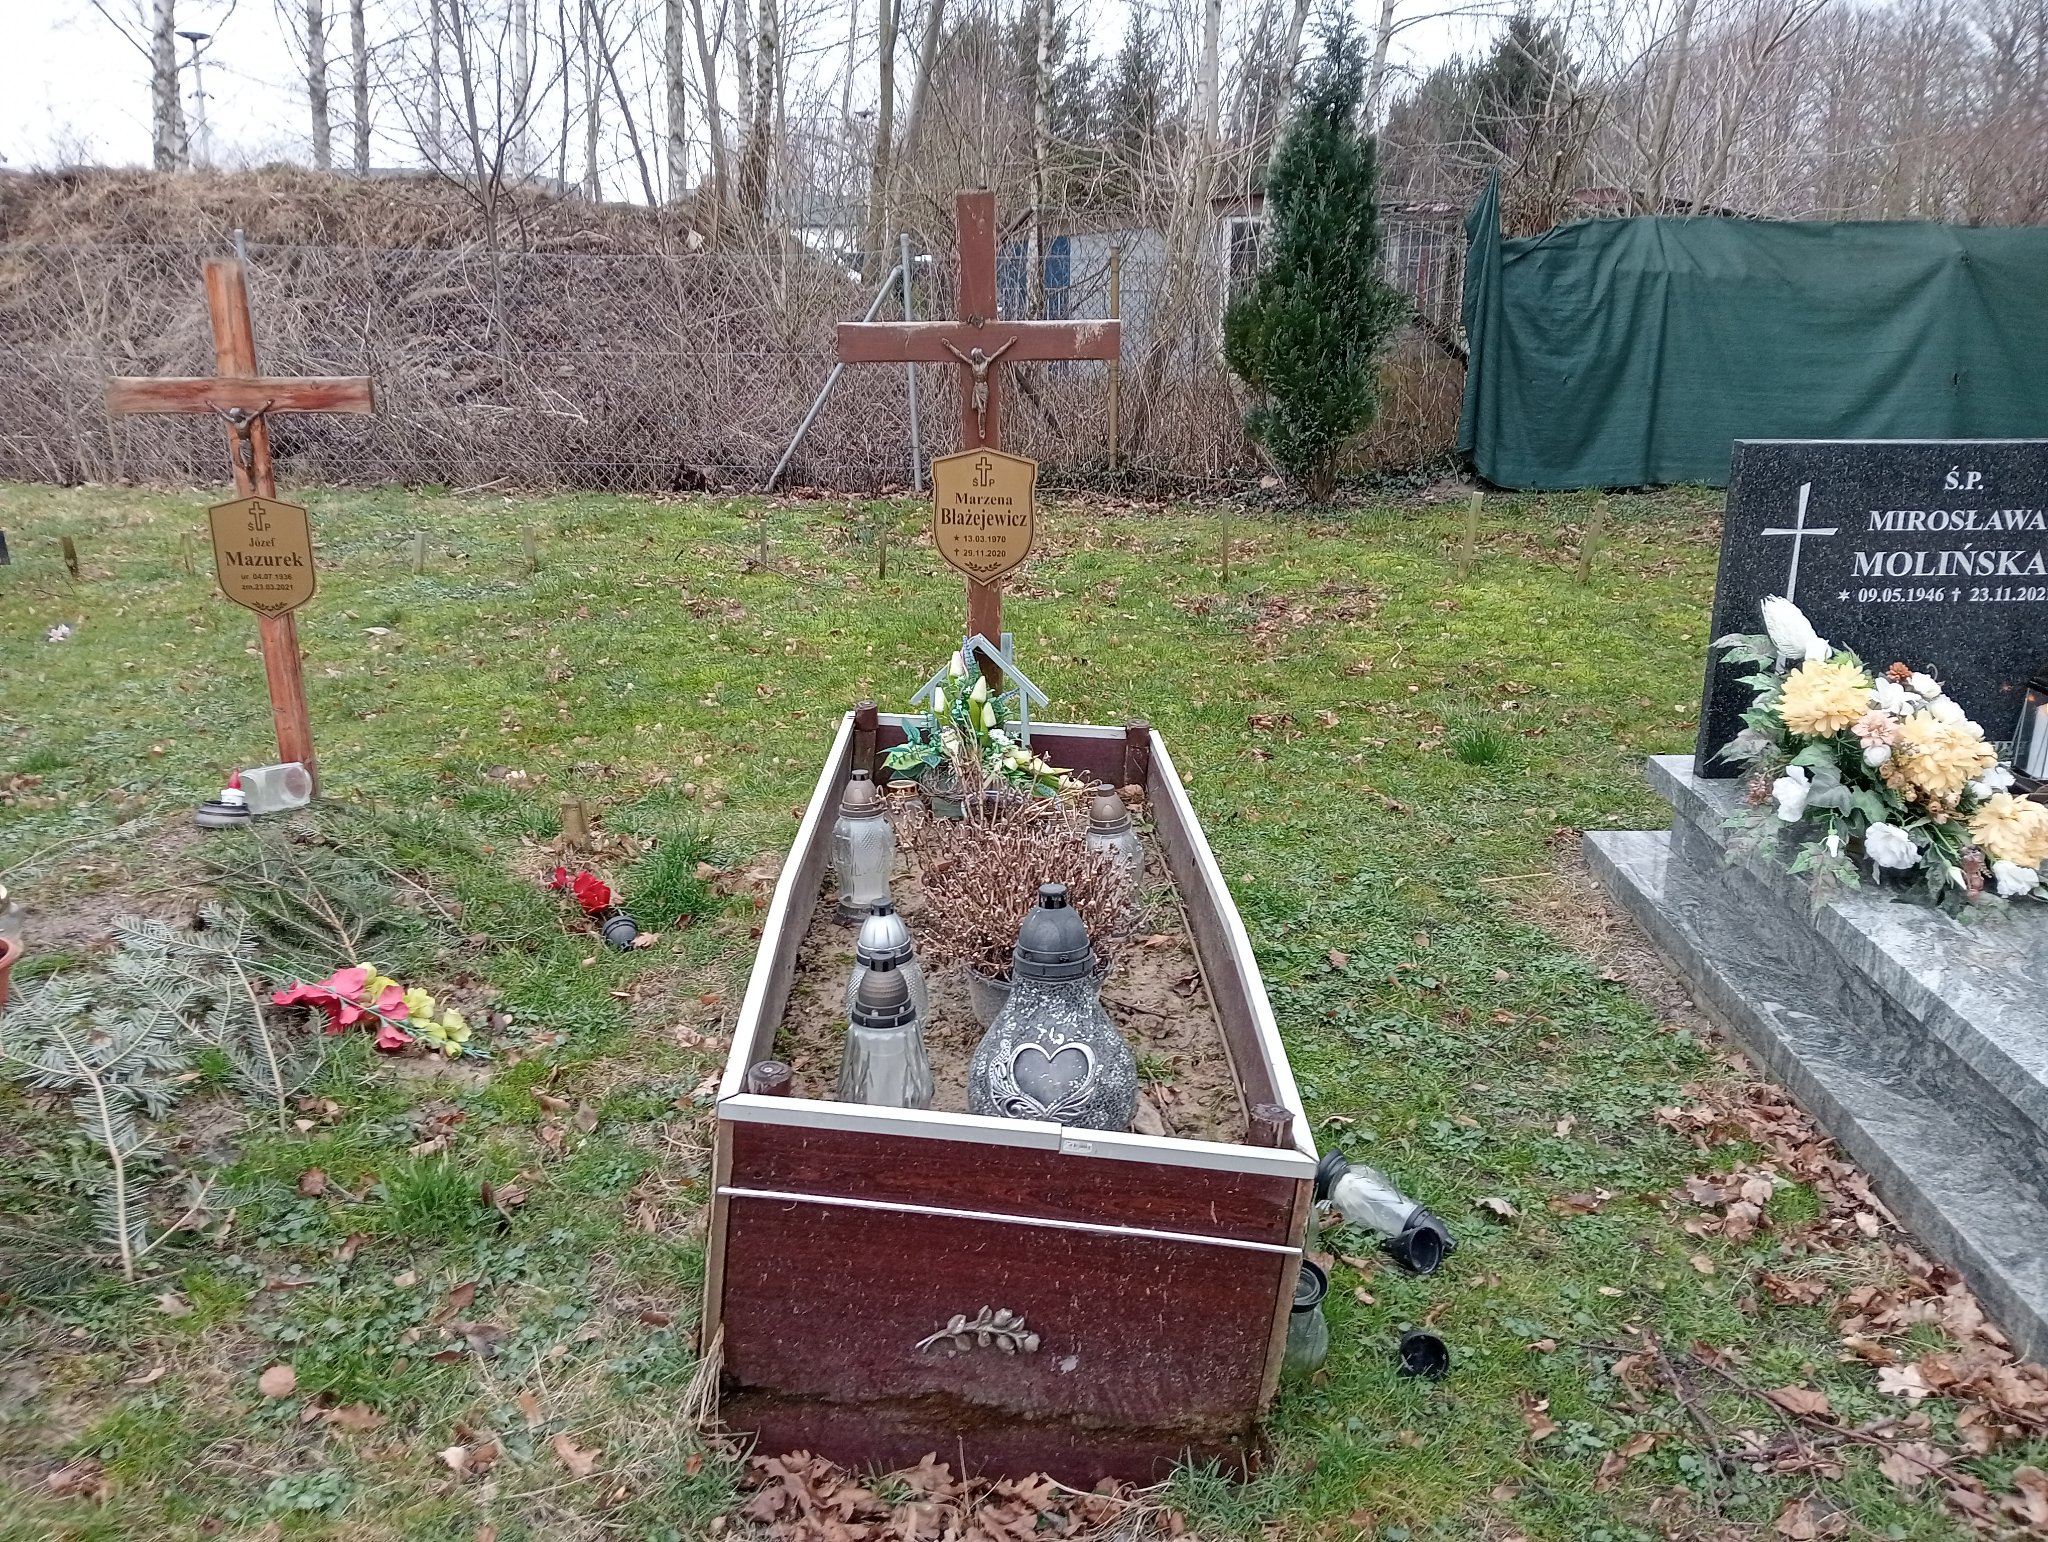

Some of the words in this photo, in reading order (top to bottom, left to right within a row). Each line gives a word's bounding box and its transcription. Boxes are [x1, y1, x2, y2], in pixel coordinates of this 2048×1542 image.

[989, 479, 995, 487] P
[1944, 465, 1985, 491] Ś.P.
[955, 492, 1013, 506] Marzena
[941, 507, 1028, 531] Błażejewicz
[1866, 509, 2048, 532] MIROSŁAWA
[264, 523, 271, 531] P
[248, 536, 276, 547] Józef
[963, 535, 1007, 543] 13.03.1970
[224, 551, 304, 567] Mazurek
[963, 549, 1007, 558] 29.11.2020
[1850, 542, 2048, 577] MOLIŃSKA
[1857, 587, 1946, 603] 09.05.1946
[1968, 586, 2048, 602] 23.11.202
